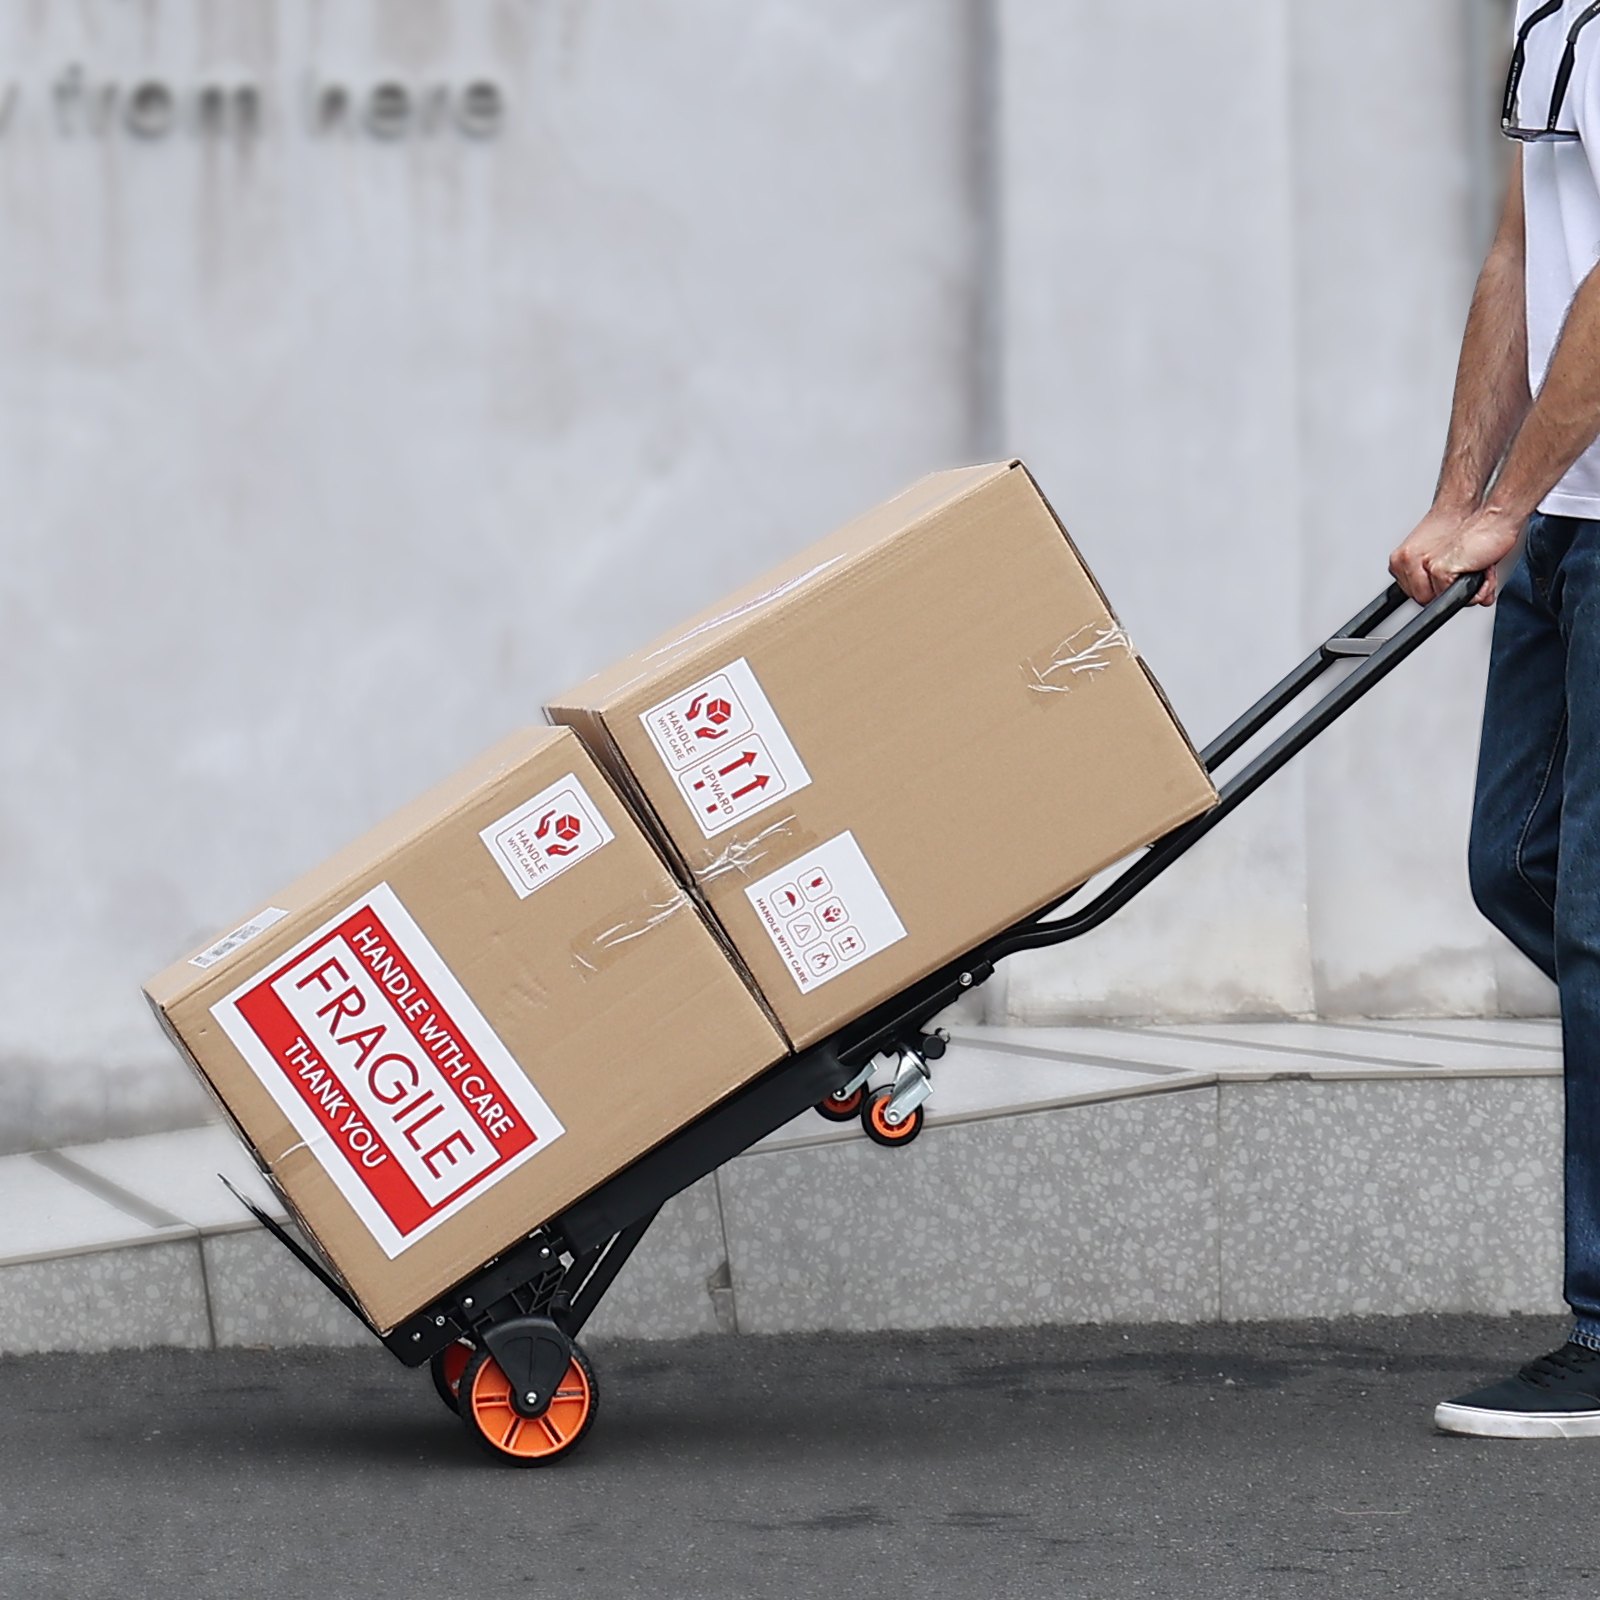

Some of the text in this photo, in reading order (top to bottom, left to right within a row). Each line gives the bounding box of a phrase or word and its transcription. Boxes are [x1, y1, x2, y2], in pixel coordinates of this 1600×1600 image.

[657, 717, 686, 761] WITH CARE
[666, 710, 697, 755] HANDLE
[701, 764, 734, 815] UPWARD
[507, 837, 537, 879] WITH CARE
[516, 829, 549, 873] HANDLE
[755, 897, 809, 985] HANDLE WITH CARE
[352, 926, 515, 1139] HANDLE WITH CARE
[295, 956, 475, 1180] FRAGILE
[283, 1036, 388, 1169] THANK YOU
